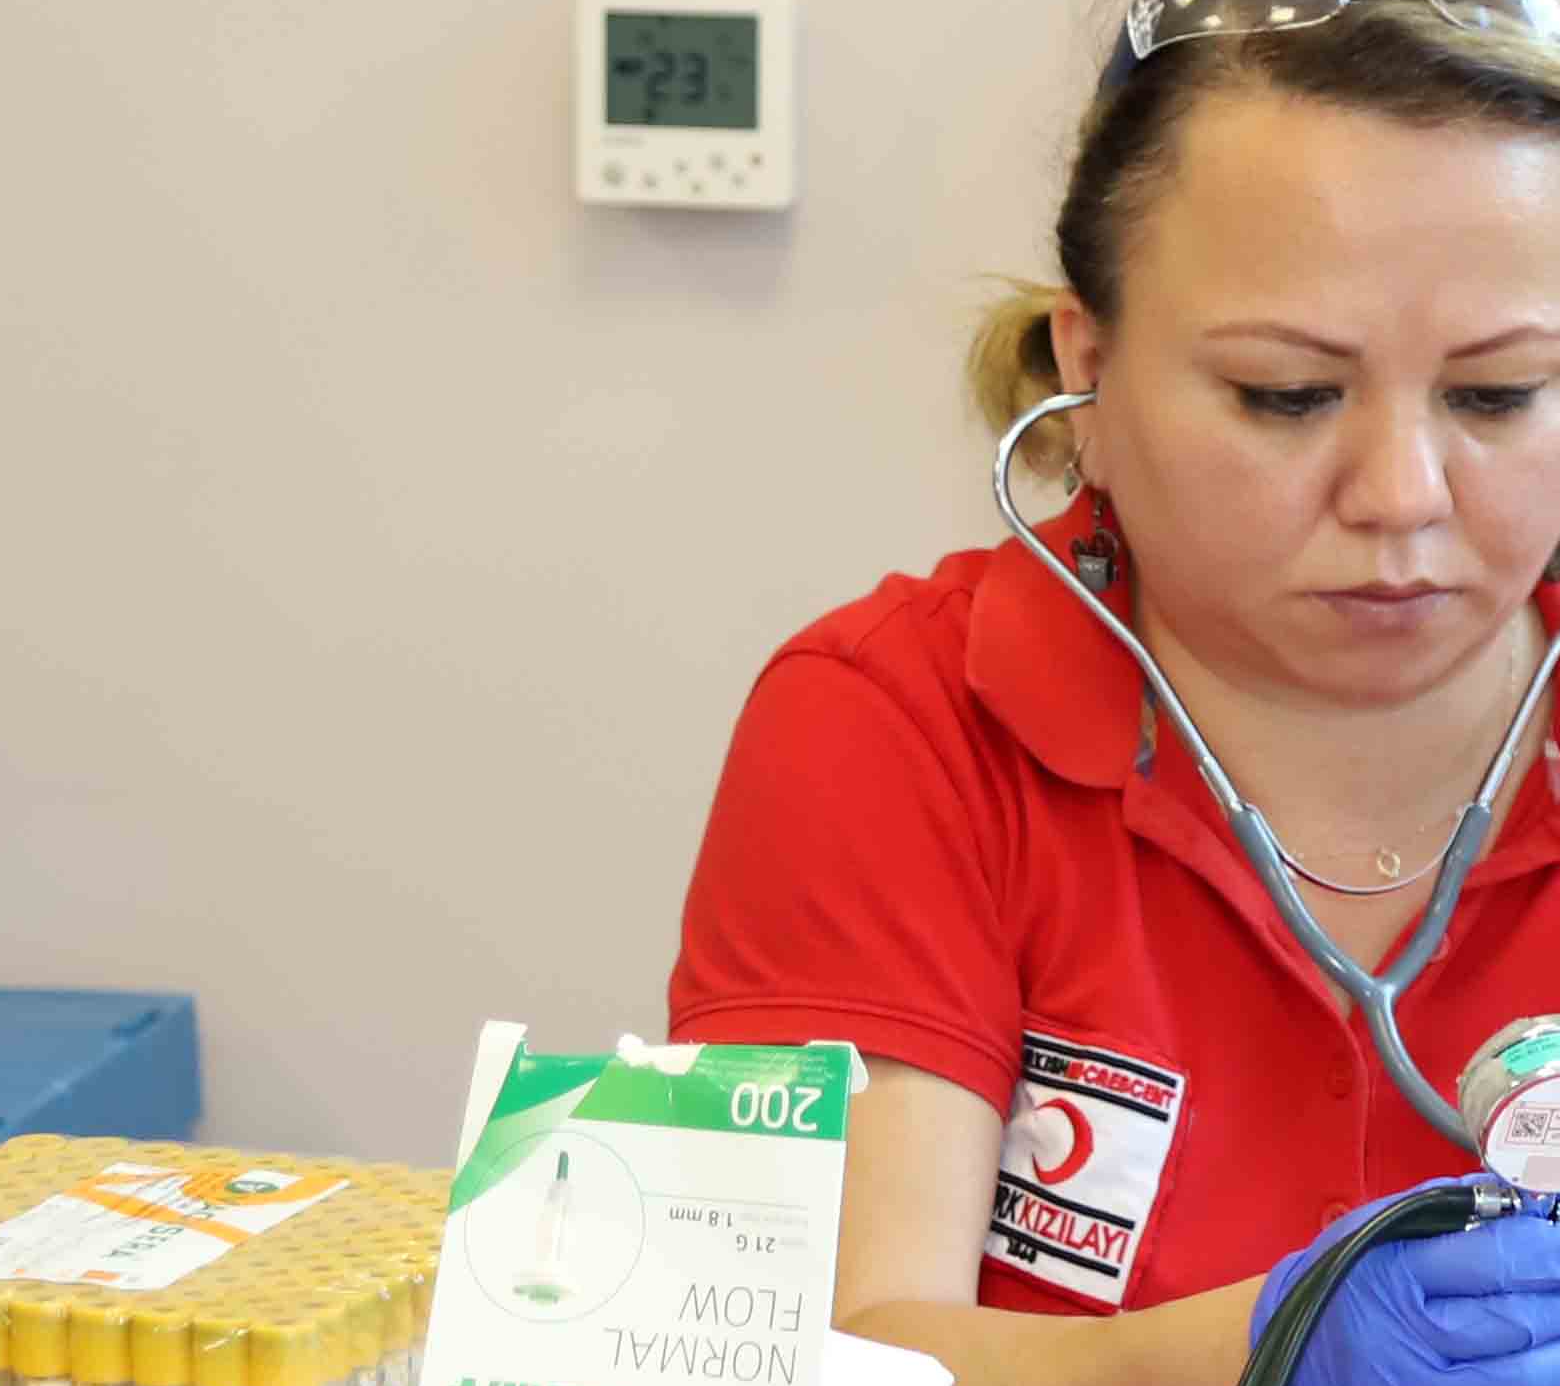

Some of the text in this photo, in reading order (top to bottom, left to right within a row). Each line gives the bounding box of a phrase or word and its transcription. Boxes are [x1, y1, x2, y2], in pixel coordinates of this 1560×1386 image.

[730, 1081, 823, 1133] 200
[668, 1207, 704, 1224] mm
[709, 1209, 734, 1228] 1.8
[735, 1234, 777, 1253] 21 G
[678, 1284, 804, 1333] FLOW
[602, 1327, 798, 1386] NORMAL
